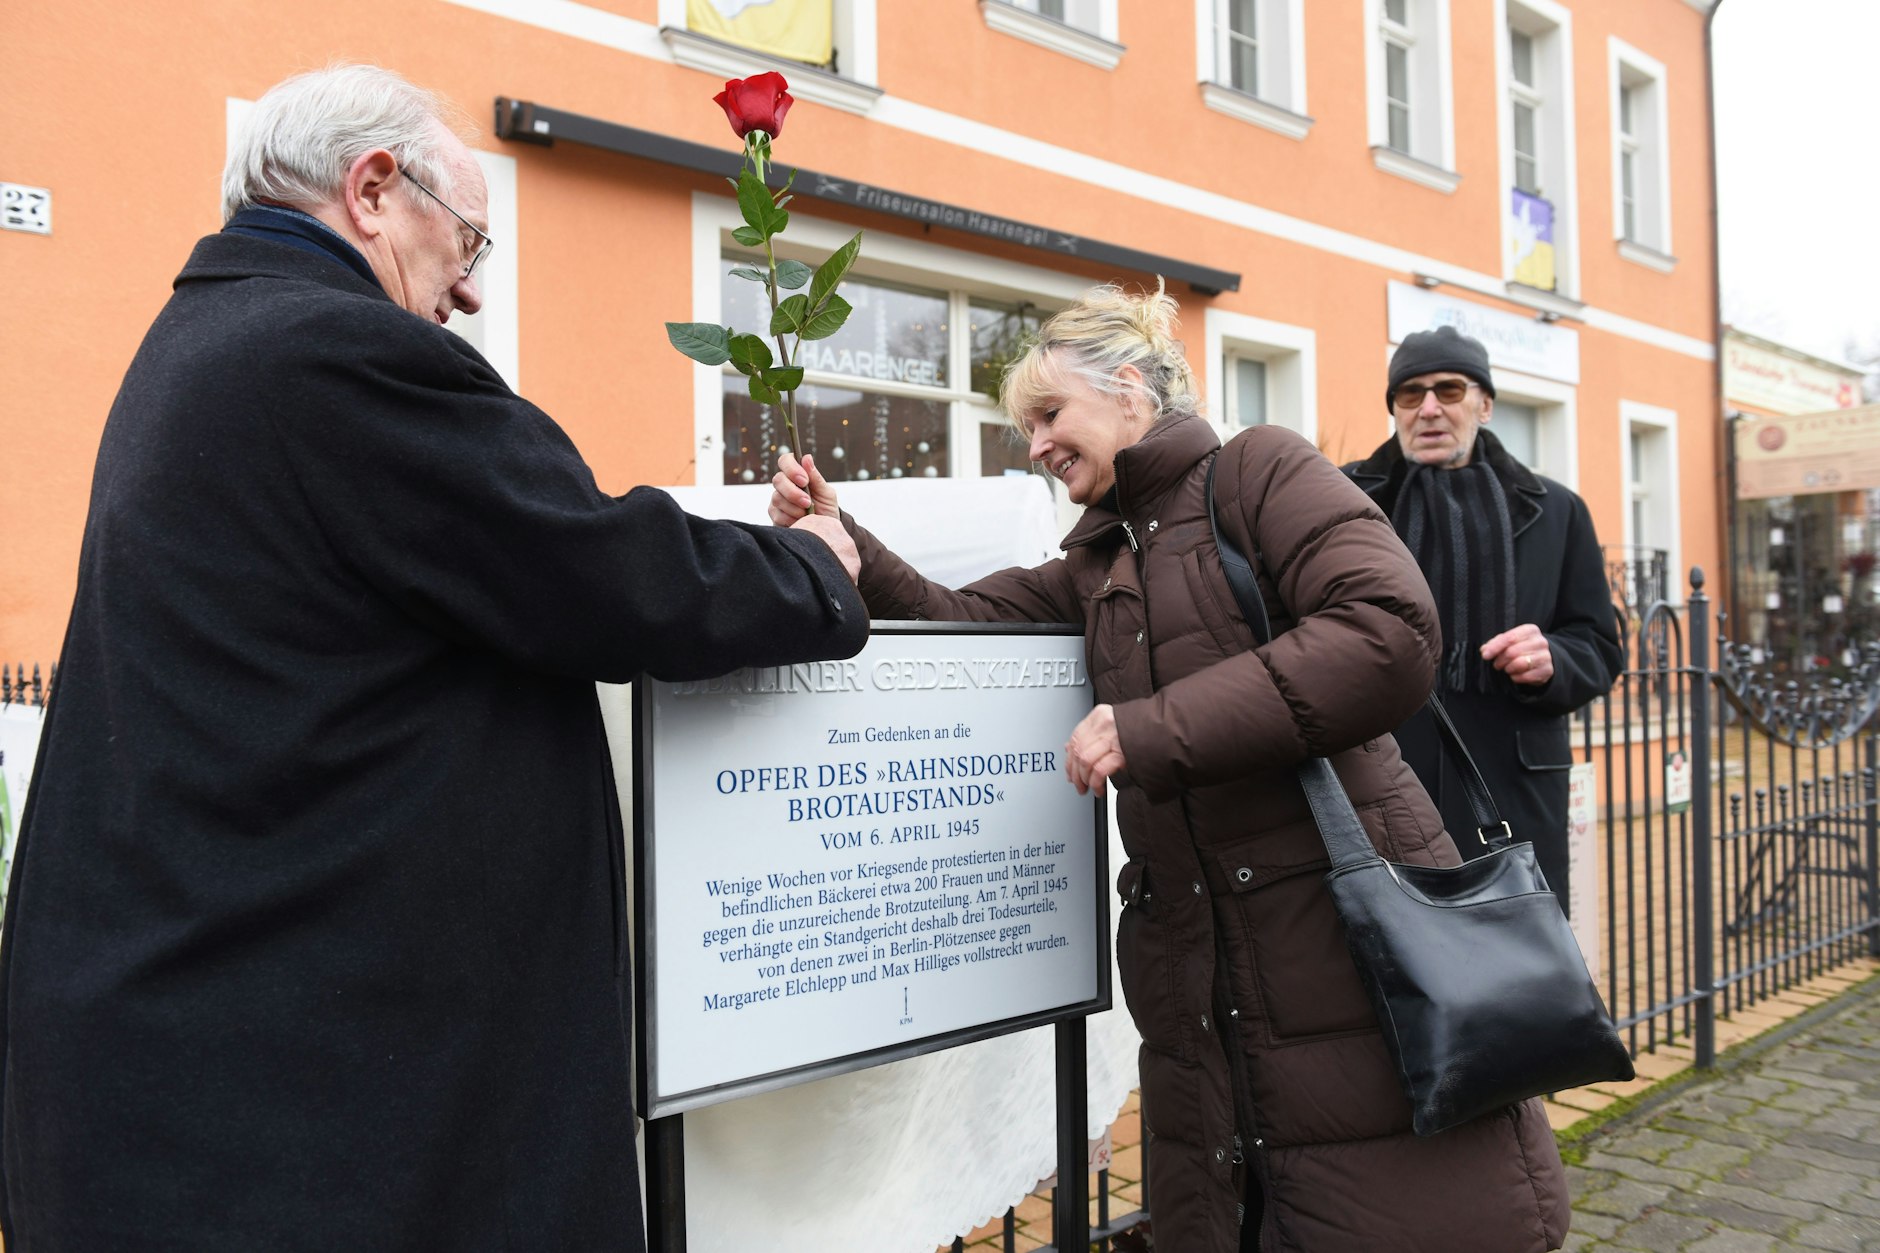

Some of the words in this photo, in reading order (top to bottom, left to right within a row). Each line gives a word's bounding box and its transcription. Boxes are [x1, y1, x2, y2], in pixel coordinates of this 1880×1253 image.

[855, 184, 965, 225] Friseursalon
[968, 212, 1049, 245] Haarengel
[871, 657, 1086, 692] GEDENKTAFEL
[828, 729, 860, 744] Zum
[865, 725, 930, 742] Gedenken
[934, 728, 949, 739] an
[953, 723, 971, 738] die
[716, 766, 809, 795] OPFER
[817, 761, 867, 788] DES
[820, 831, 862, 851] VOM
[870, 828, 884, 846] 6.
[890, 824, 941, 844] APRIL
[947, 818, 980, 838] 1945
[705, 876, 762, 897] Wenige
[766, 870, 826, 890] Wochen
[830, 869, 853, 882] vor
[857, 856, 928, 880] Kriegsende
[931, 850, 1006, 874] protestierten
[1009, 846, 1020, 860] in
[1023, 843, 1042, 858] der
[1044, 841, 1066, 856] hier
[721, 893, 813, 918] befindlichen
[818, 882, 876, 905] Bäckerei
[880, 882, 911, 897] etwa
[914, 875, 938, 892] 200
[941, 873, 983, 889] Frauen
[986, 865, 1009, 883] und
[1012, 863, 1055, 879] Männer
[703, 926, 747, 948] gegen
[752, 918, 774, 936] die
[779, 903, 881, 932] unzureichende
[885, 893, 972, 917] Brotzuteilung.
[976, 889, 997, 903] Am
[1000, 885, 1008, 899] 7.
[1012, 880, 1039, 901] April
[1043, 876, 1068, 893] 1945
[719, 939, 793, 963] verhängte
[797, 933, 819, 951] ein
[824, 920, 908, 947] Standgericht
[911, 912, 958, 933] deshalb
[962, 907, 985, 925] drei
[987, 897, 1057, 921] Todesurteile,
[703, 985, 780, 1012] Margarete
[785, 974, 847, 997] Elchlepp
[851, 965, 877, 985] und
[881, 963, 910, 979] Max
[914, 953, 960, 973] Hilliges
[963, 941, 1023, 963] vollstreckt
[1026, 934, 1069, 952] wurden.
[757, 964, 785, 979] von
[790, 956, 833, 974] denen
[838, 946, 868, 966] zwei
[873, 944, 885, 960] in
[890, 929, 996, 957] Berlin-Plötzensee
[999, 923, 1031, 942] gegen
